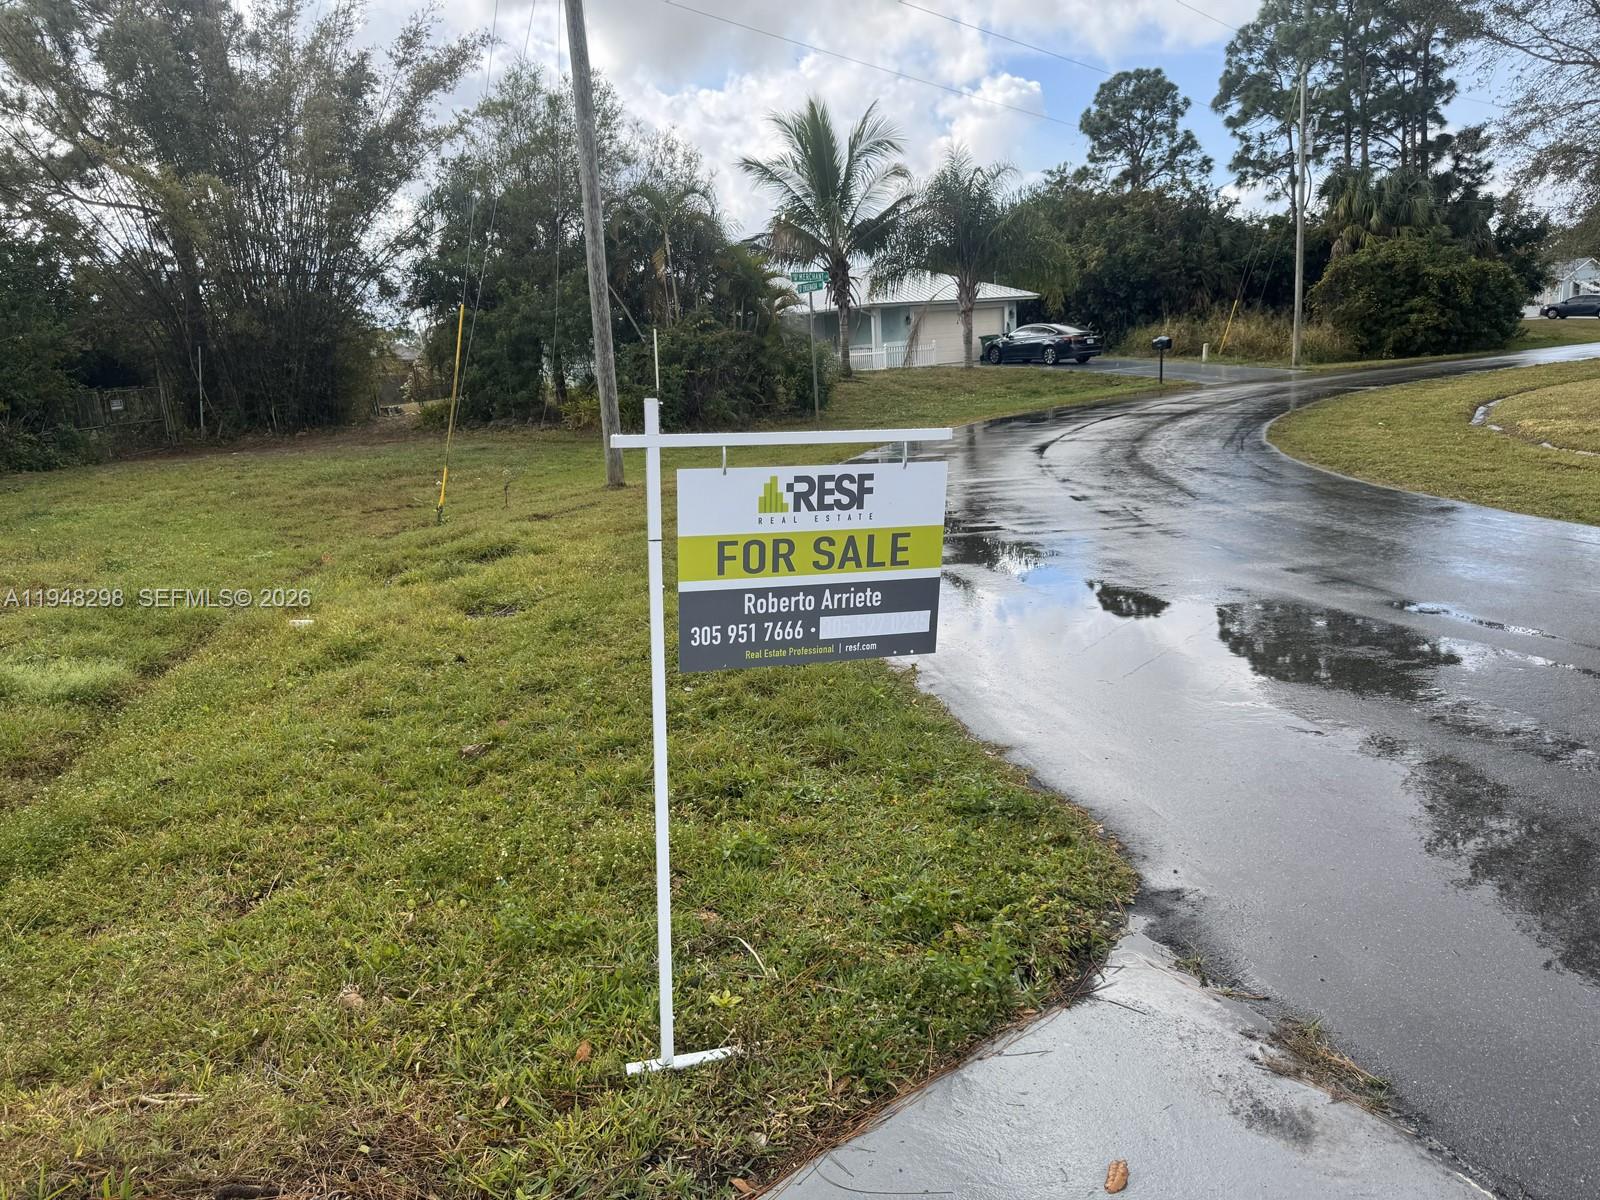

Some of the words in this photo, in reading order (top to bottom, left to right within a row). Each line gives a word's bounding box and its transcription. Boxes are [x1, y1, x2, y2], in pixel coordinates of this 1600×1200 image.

[786, 473, 874, 512] RESF
[758, 515, 797, 525] REAL
[814, 512, 873, 523] ESTATE
[717, 538, 796, 576] FOR
[812, 532, 911, 571] SALE
[744, 592, 815, 615] Roberto
[821, 587, 882, 610] Arriete
[690, 625, 721, 646] 305
[727, 623, 756, 644] 951
[764, 620, 804, 641] 7666
[745, 650, 762, 659] Real
[764, 648, 787, 658] Estate
[789, 644, 834, 656] Professional
[845, 642, 877, 652] resf.com
